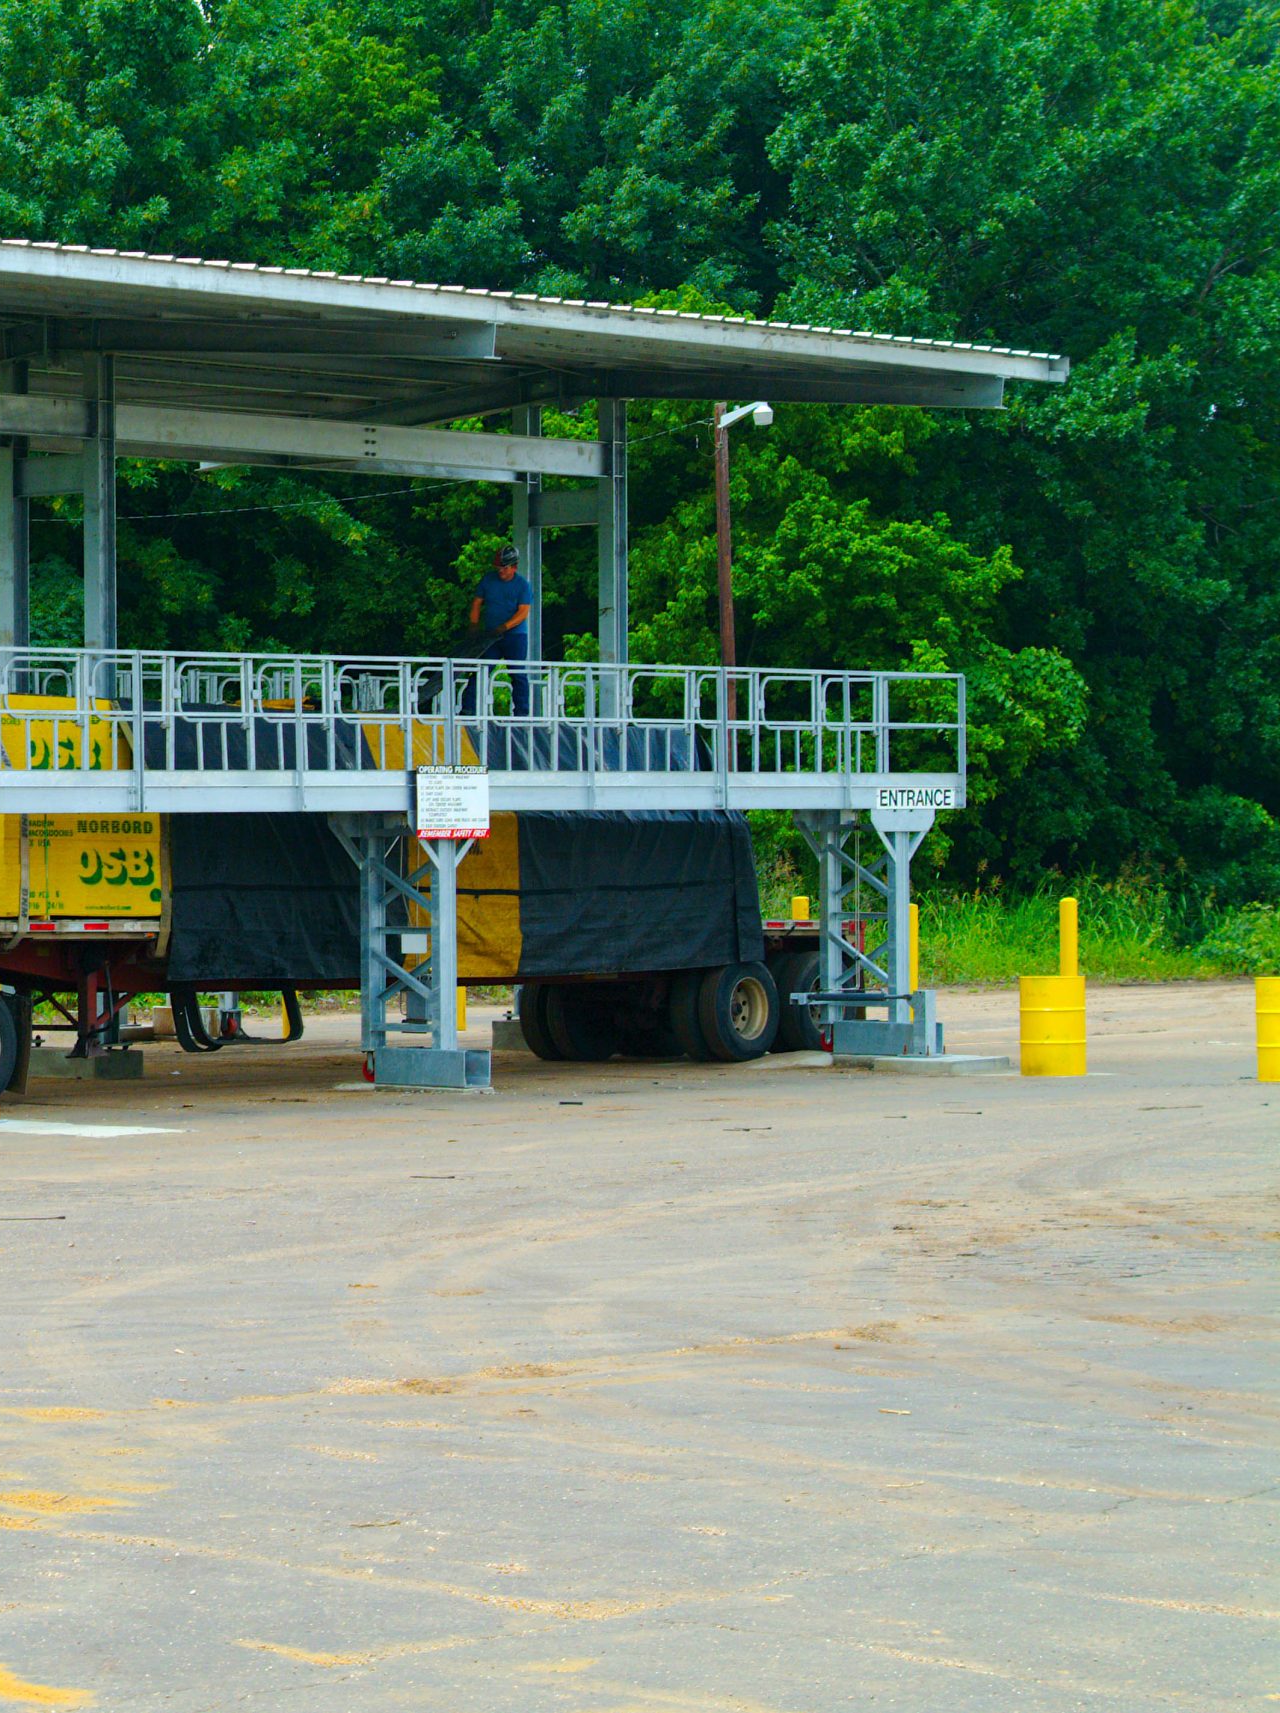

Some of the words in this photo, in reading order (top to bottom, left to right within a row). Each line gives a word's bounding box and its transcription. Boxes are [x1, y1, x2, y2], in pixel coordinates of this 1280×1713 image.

[880, 789, 951, 806] ENTRANCE
[77, 820, 153, 833] NORBORD
[78, 846, 155, 886] OSB
